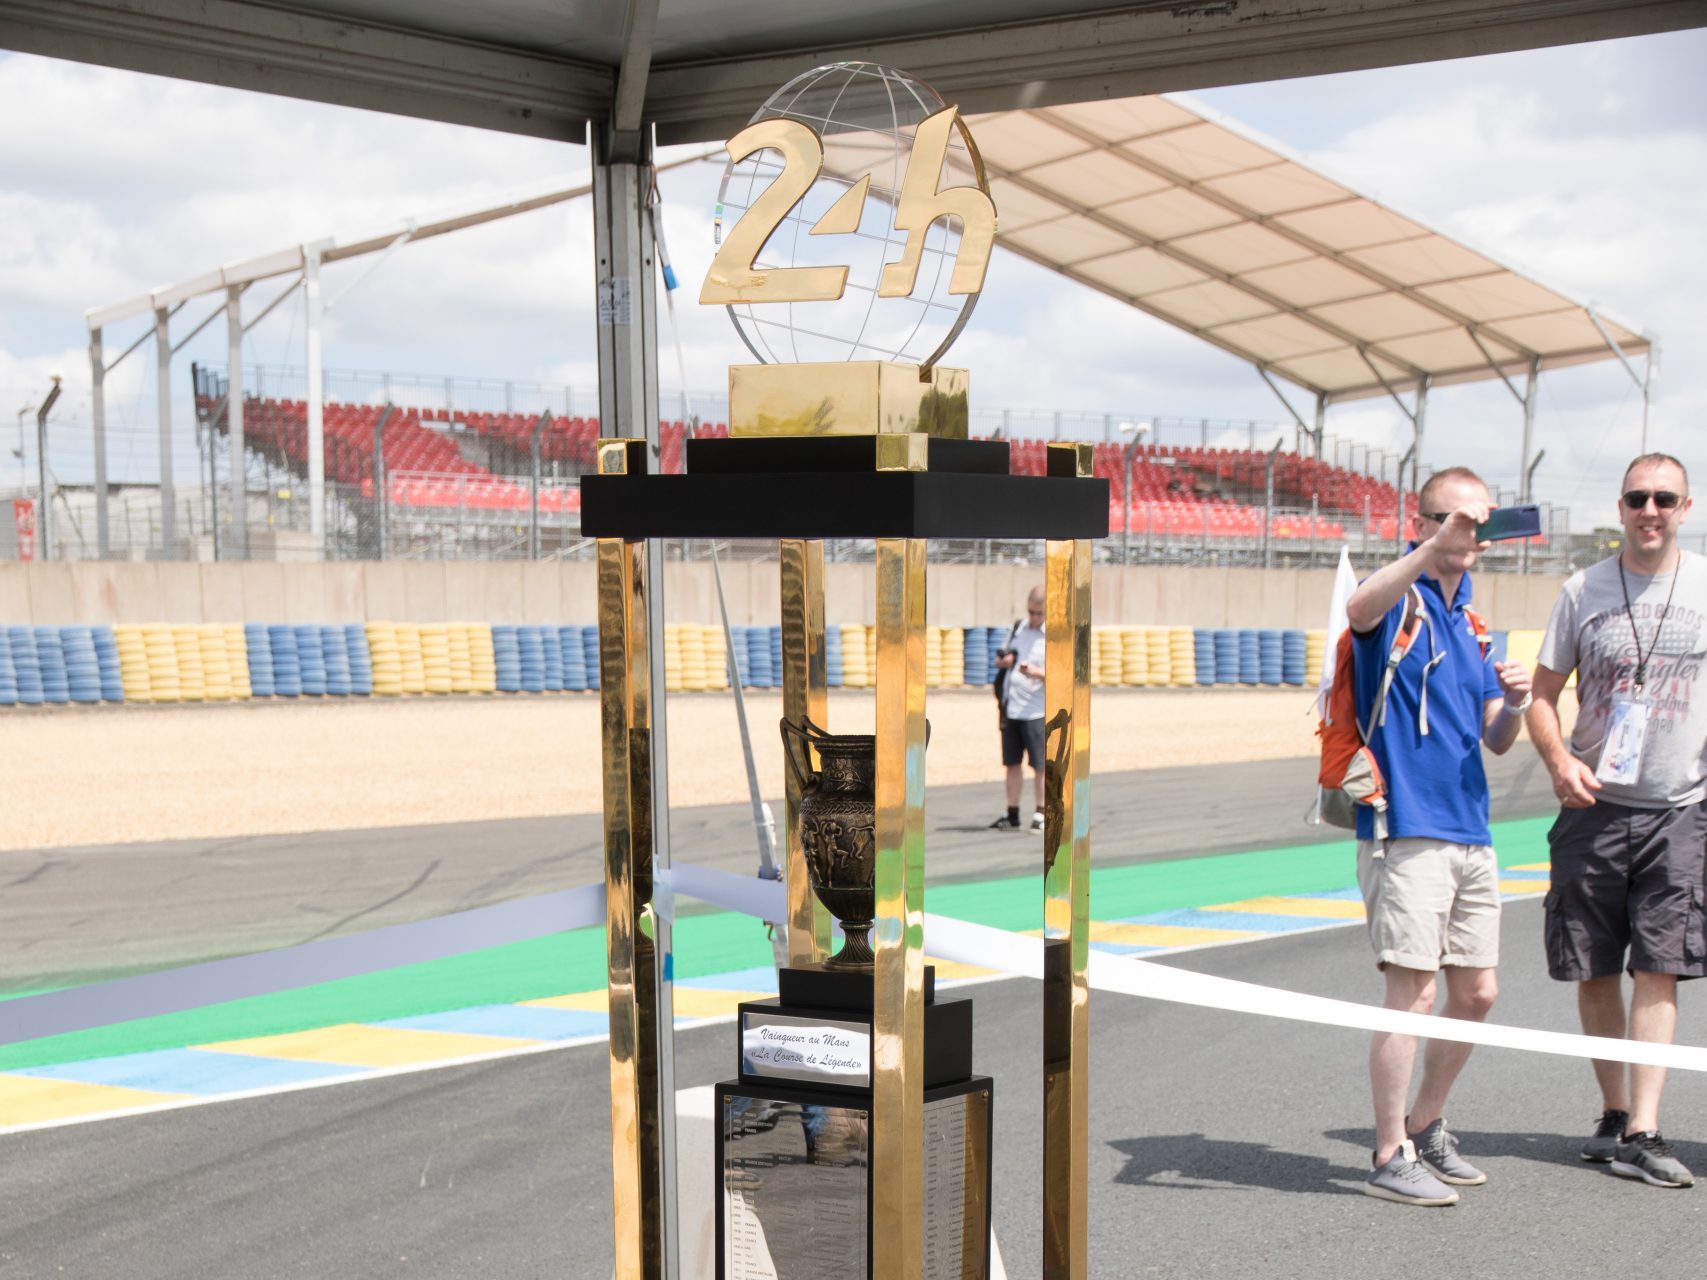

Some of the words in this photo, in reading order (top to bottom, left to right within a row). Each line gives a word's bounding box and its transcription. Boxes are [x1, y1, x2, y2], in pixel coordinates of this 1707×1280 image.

[698, 104, 997, 305] 24h
[1654, 603, 1705, 630] GOODS
[808, 1035, 820, 1045] au
[822, 1034, 850, 1048] Mans
[773, 1048, 804, 1063] Course
[806, 1054, 817, 1064] de
